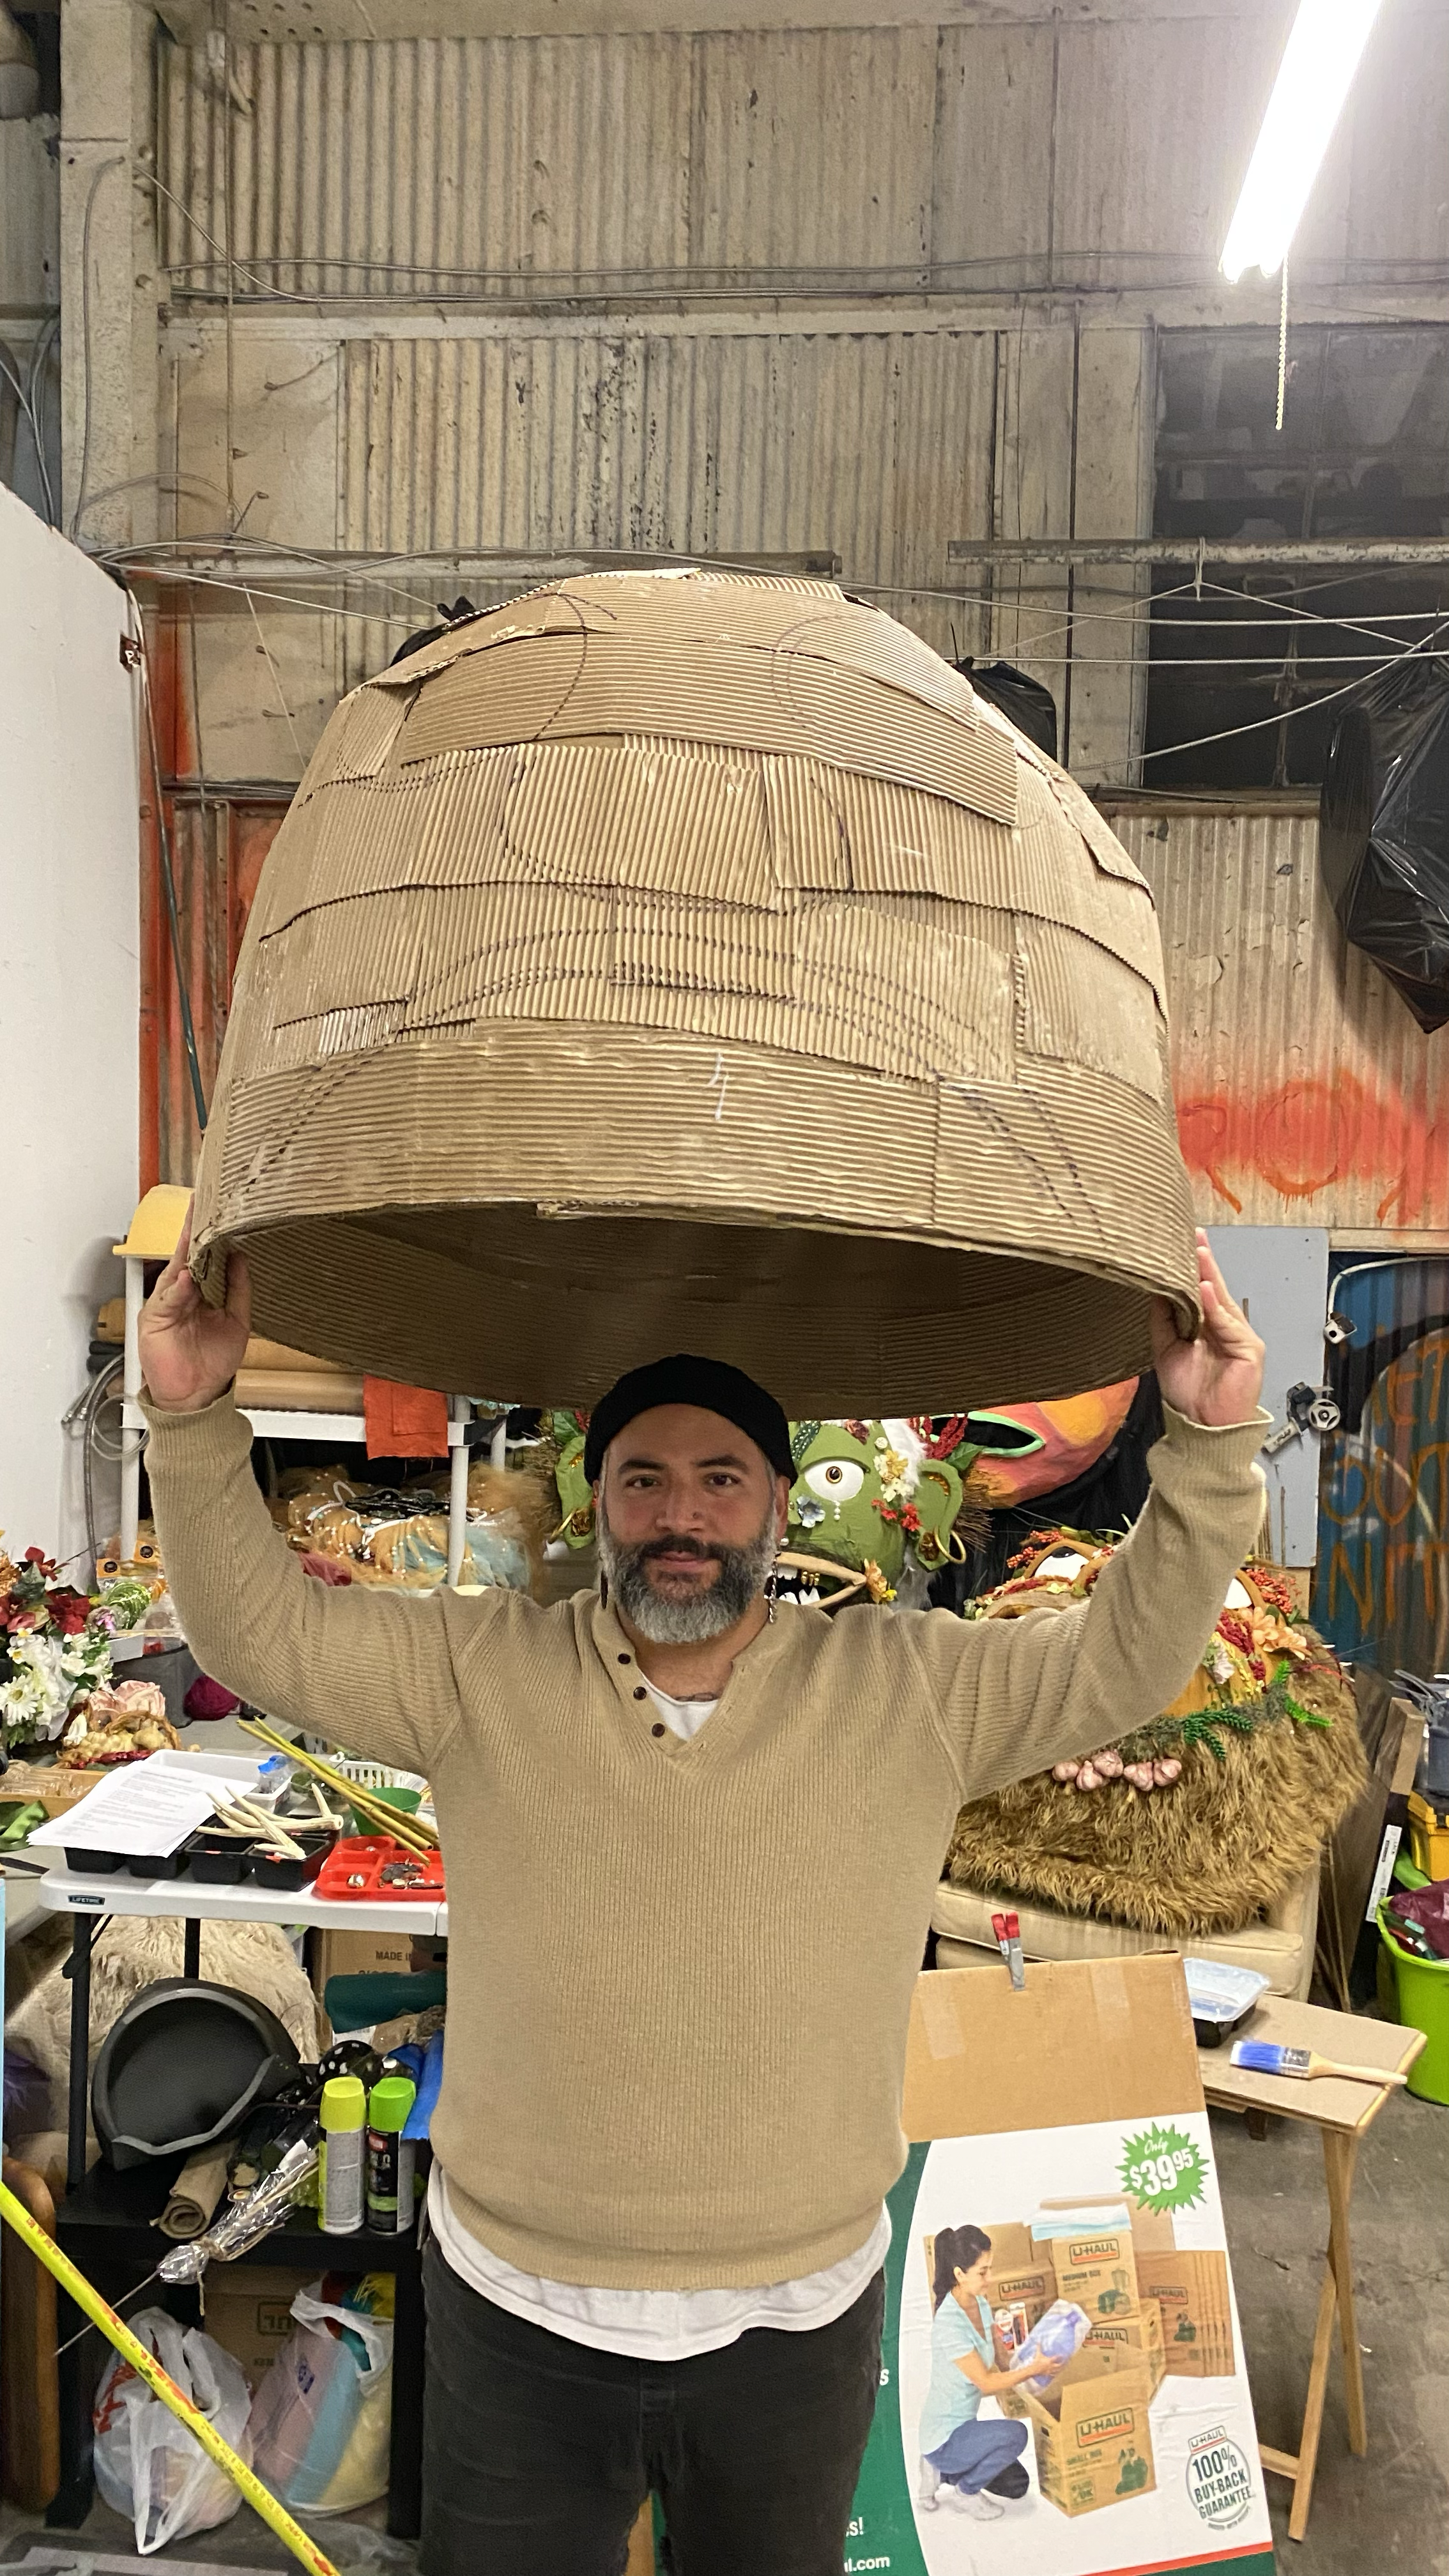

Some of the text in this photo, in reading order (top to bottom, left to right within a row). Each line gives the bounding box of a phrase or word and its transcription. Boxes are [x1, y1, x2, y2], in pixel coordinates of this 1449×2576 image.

[376, 1951, 402, 1961] MADE
[1144, 2136, 1169, 2155] Only
[1080, 2412, 1130, 2436] U-HAUL
[1191, 2429, 1223, 2448] U-HAUL
[1192, 2445, 1238, 2481] 100%
[1194, 2469, 1246, 2504] BUY-BACK
[1199, 2486, 1252, 2519] GUARANTEE
